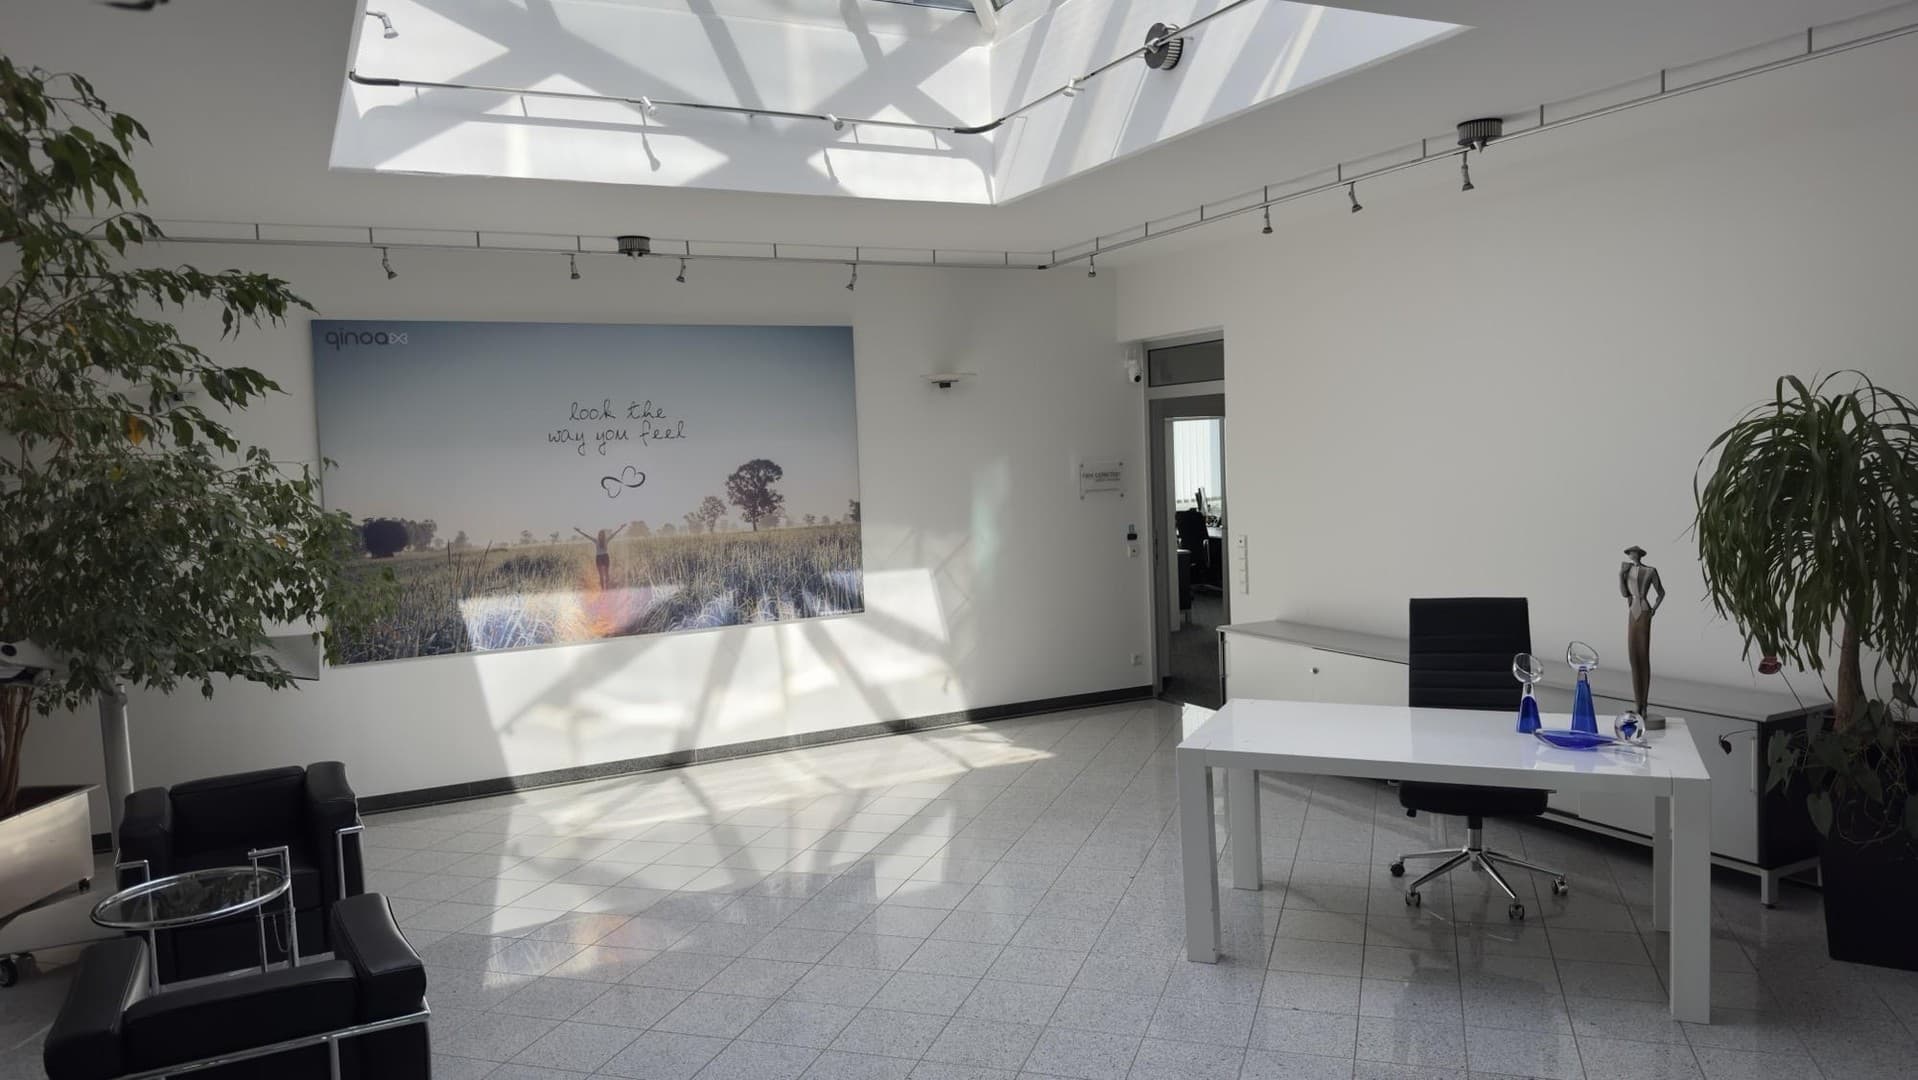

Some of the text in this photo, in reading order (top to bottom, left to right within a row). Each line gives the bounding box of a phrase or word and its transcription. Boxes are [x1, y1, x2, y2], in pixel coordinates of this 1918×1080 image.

[568, 398, 666, 421] look the
[548, 419, 686, 456] way you feel
